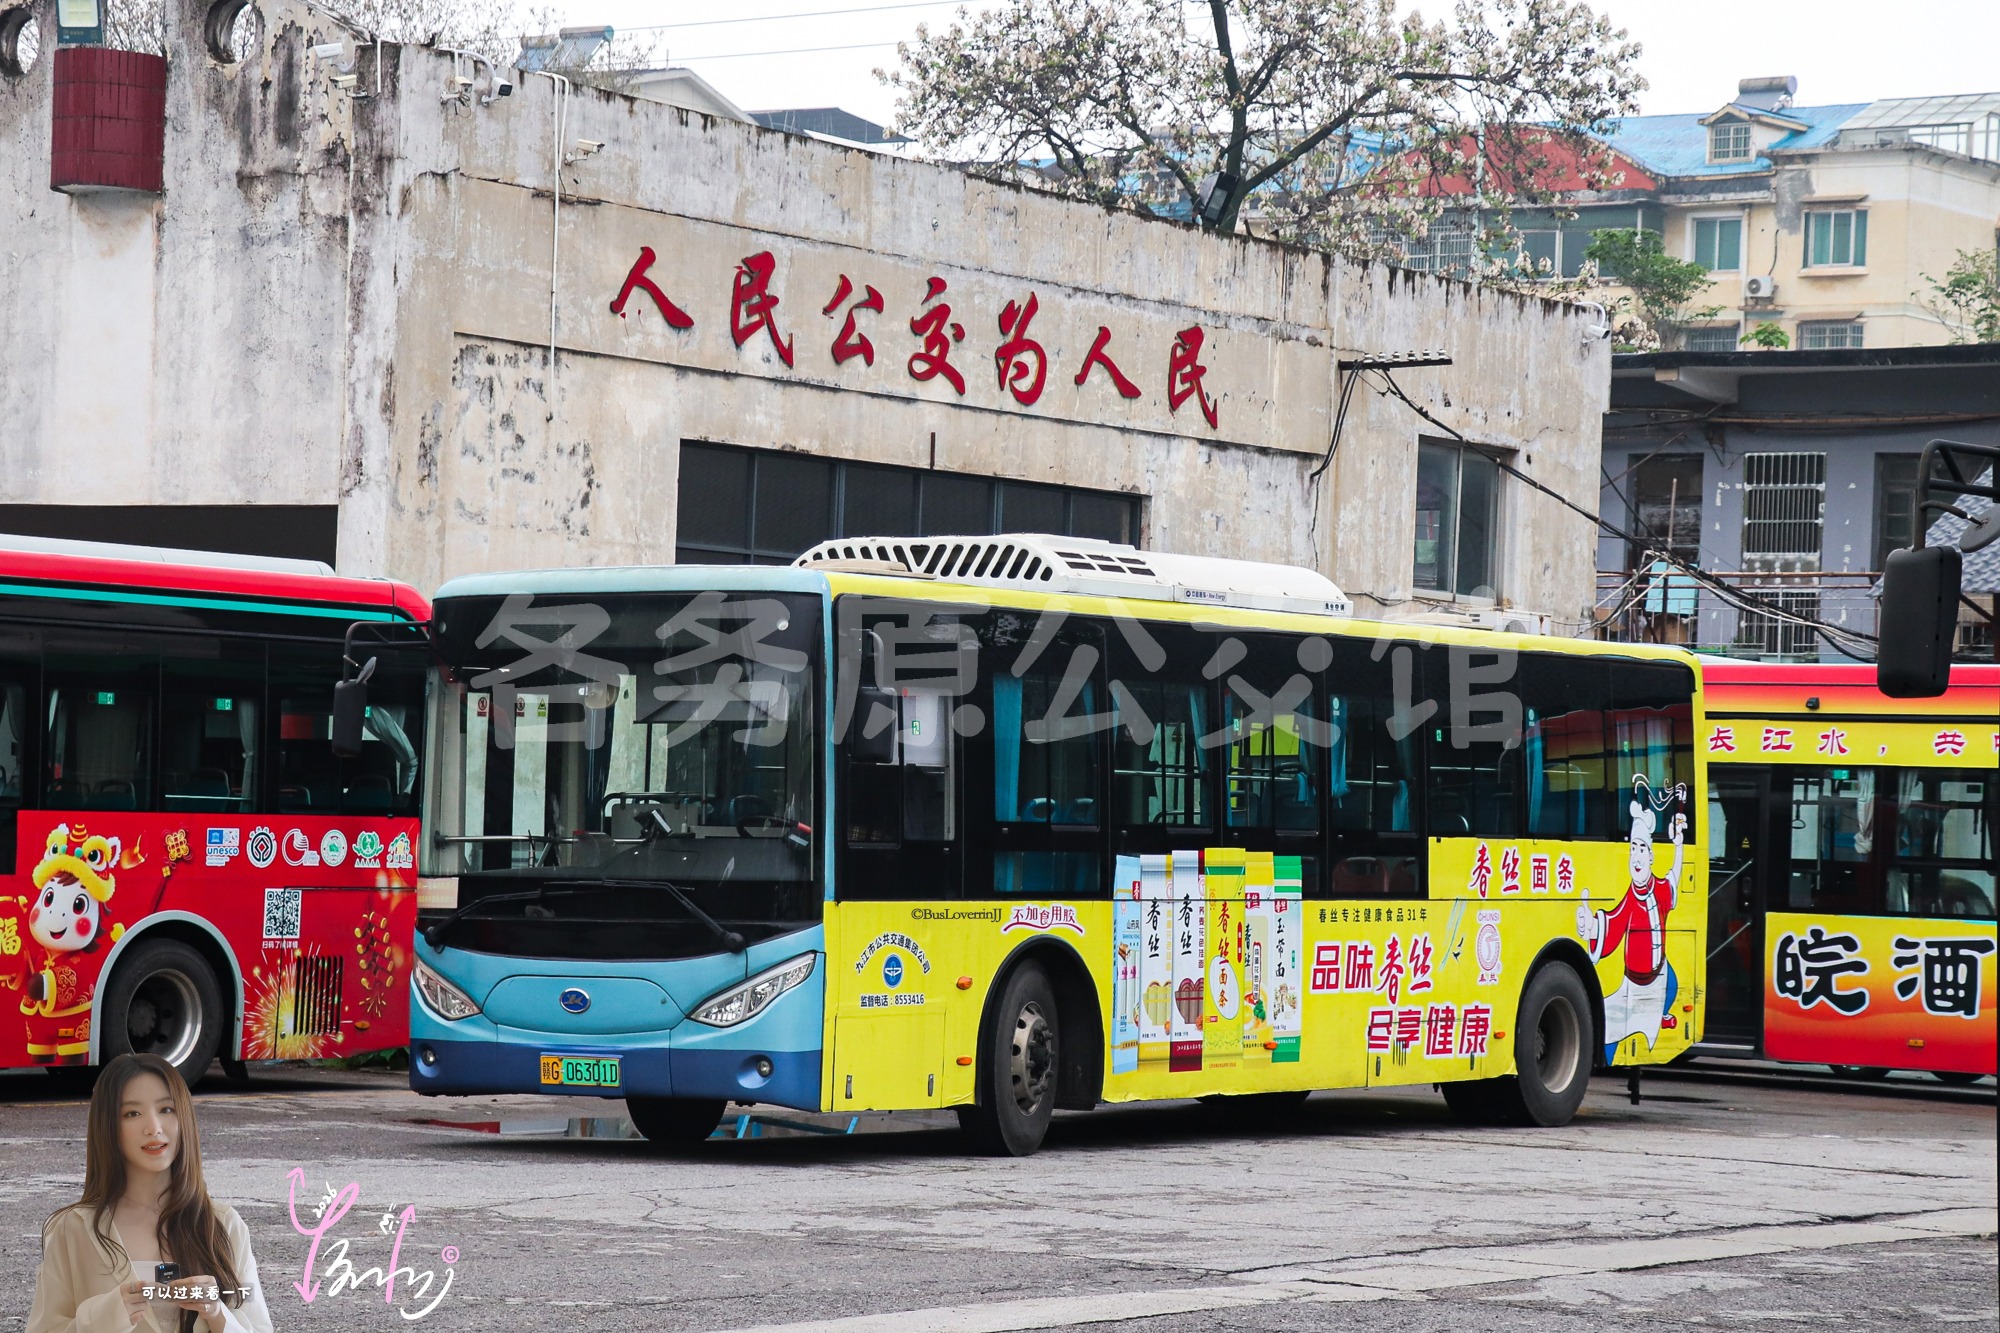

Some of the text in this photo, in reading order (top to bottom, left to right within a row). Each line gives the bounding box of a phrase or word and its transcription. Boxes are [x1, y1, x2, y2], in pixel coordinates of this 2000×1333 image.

[610, 246, 1218, 430] 人民公交为人民
[207, 846, 239, 855] unesco
[1470, 844, 1573, 898] 春丝面条
[1013, 905, 1076, 926] 不加食用胶
[1319, 908, 1427, 923] 春丝专注健康食品31年
[855, 932, 931, 974] 九江市公共交通集团公司
[1310, 936, 1433, 1005] 品味春丝
[1776, 928, 1995, 1017] 皖酒
[1367, 1004, 1491, 1056] 尽享健康
